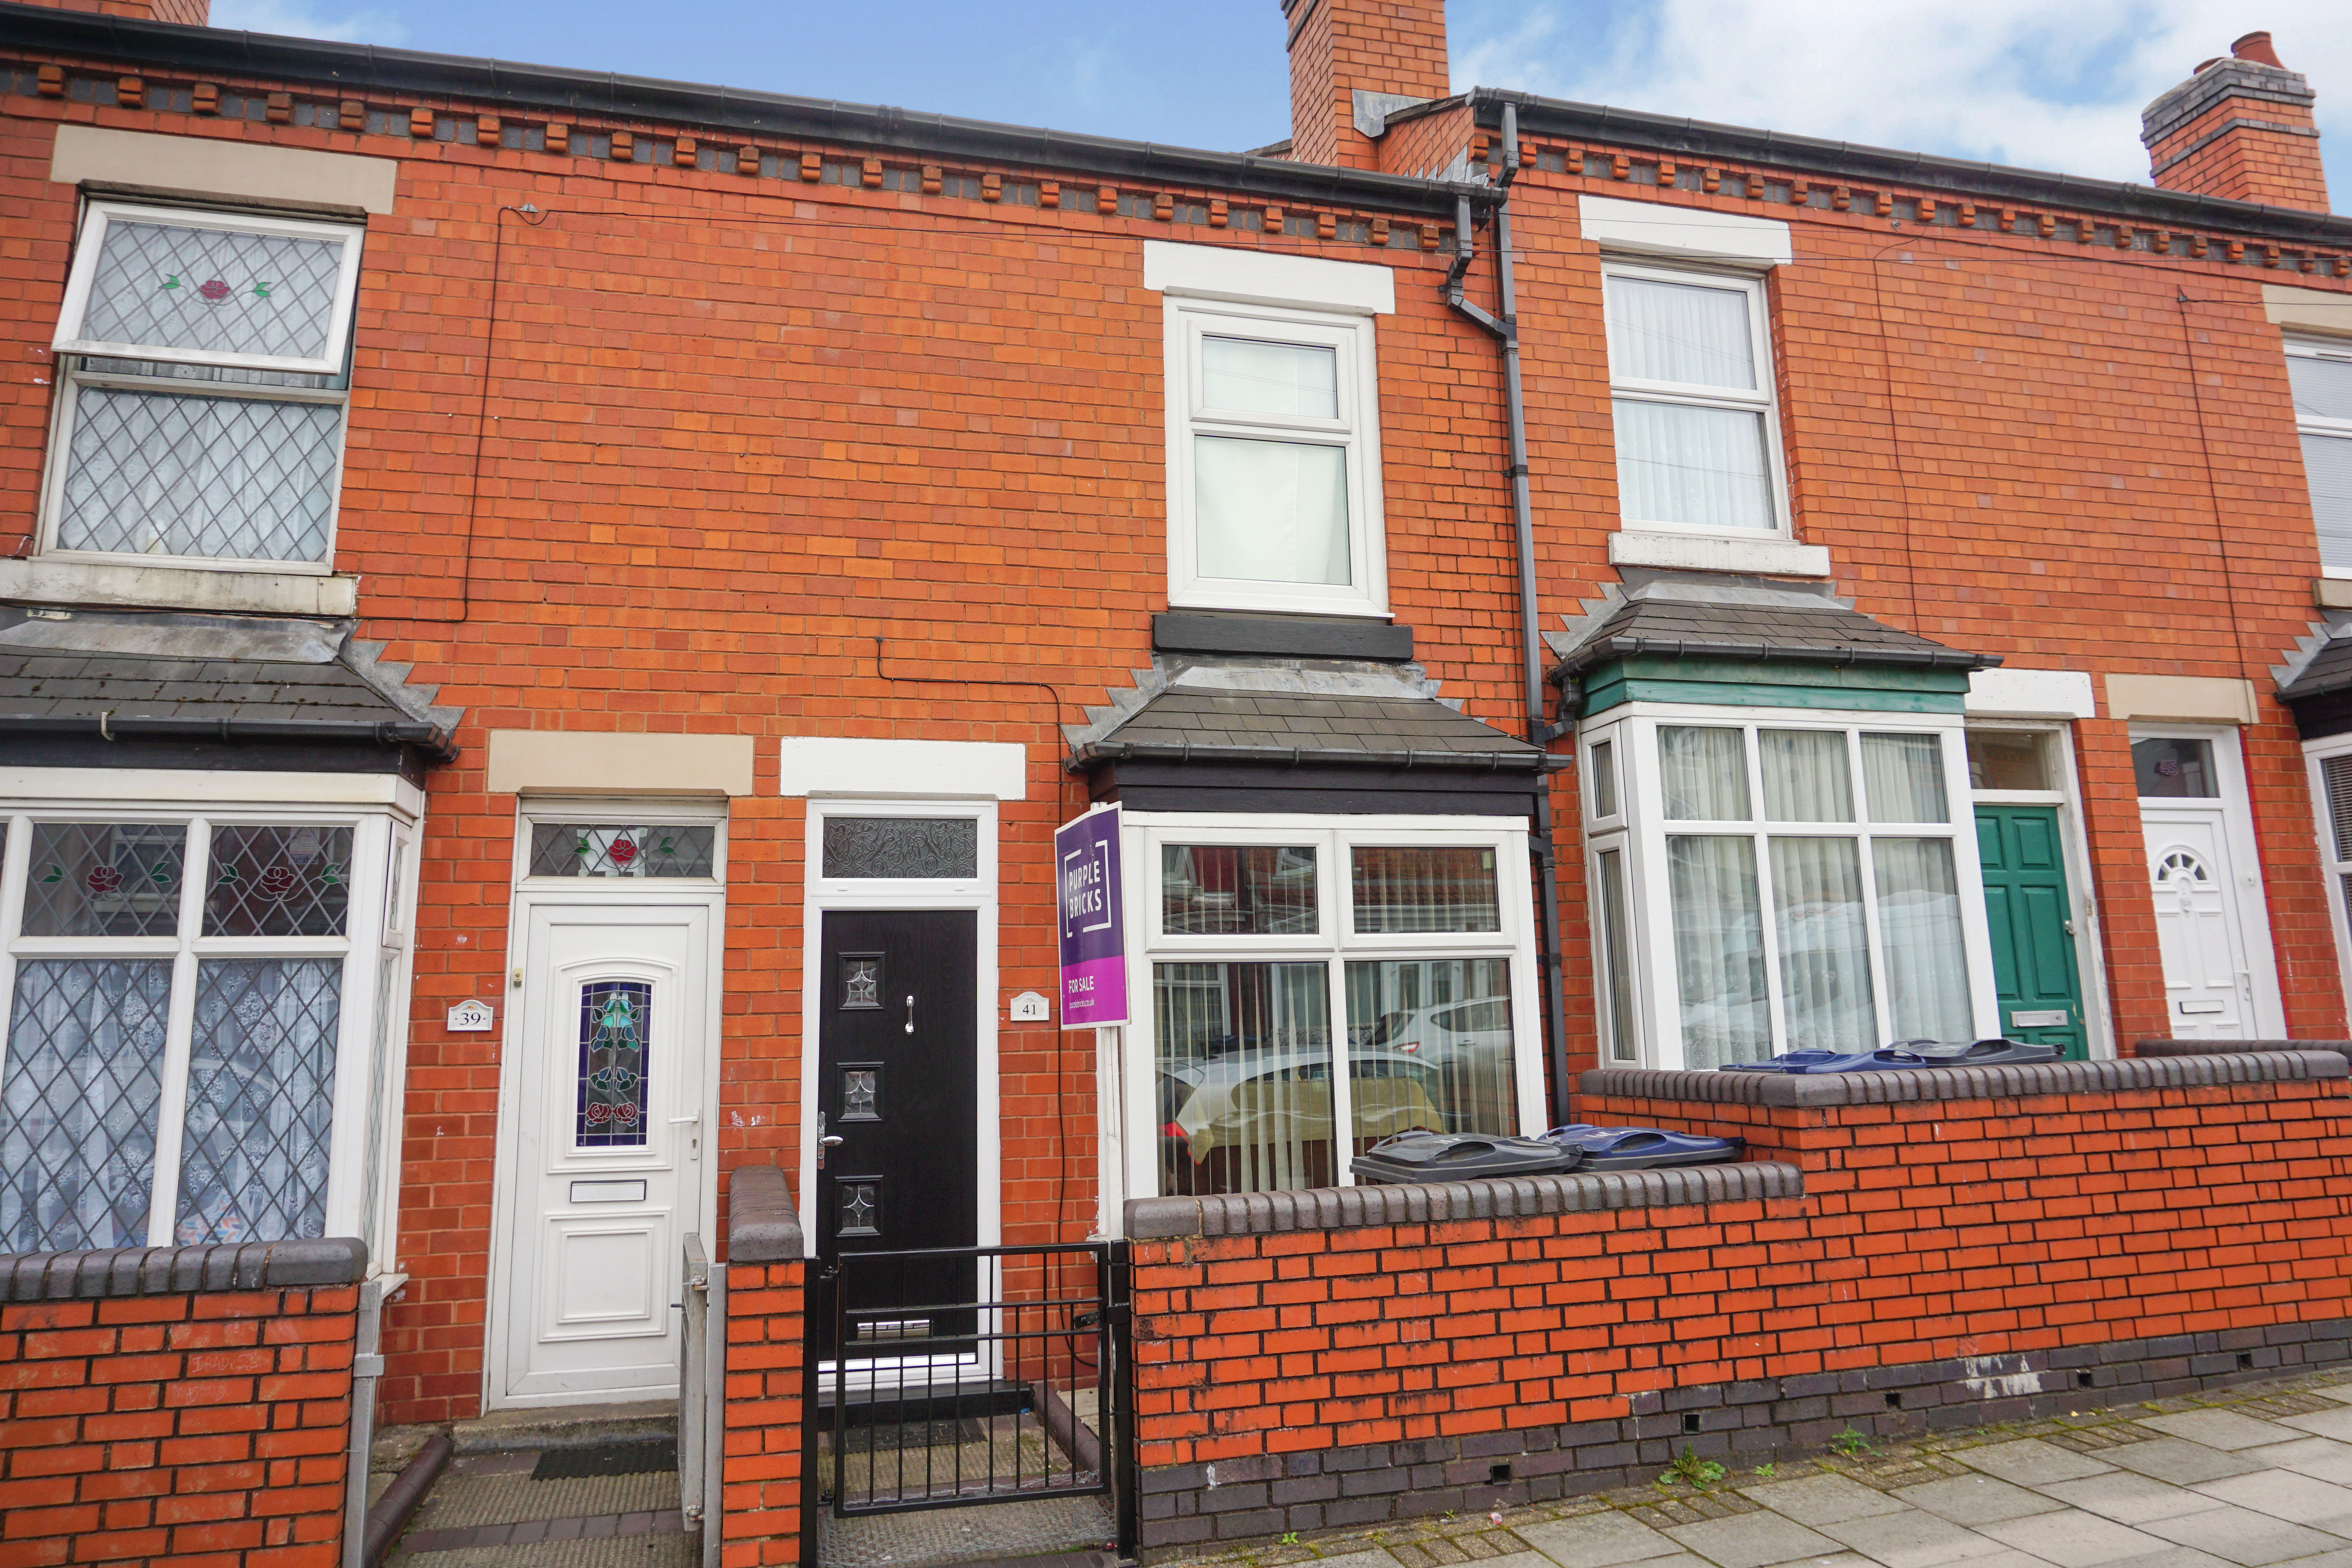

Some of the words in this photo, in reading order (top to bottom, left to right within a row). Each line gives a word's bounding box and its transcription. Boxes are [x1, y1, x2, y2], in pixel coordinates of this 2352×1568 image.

[2160, 760, 2178, 775] 45
[1069, 860, 1100, 892] PURPLE
[1069, 888, 1102, 919] BRICKS
[1069, 978, 1078, 994] FOR
[1079, 975, 1094, 992] SALE
[1022, 1004, 1036, 1015] 41
[1069, 997, 1095, 1011] purplebricks.co.uk
[460, 1013, 481, 1025] 39
